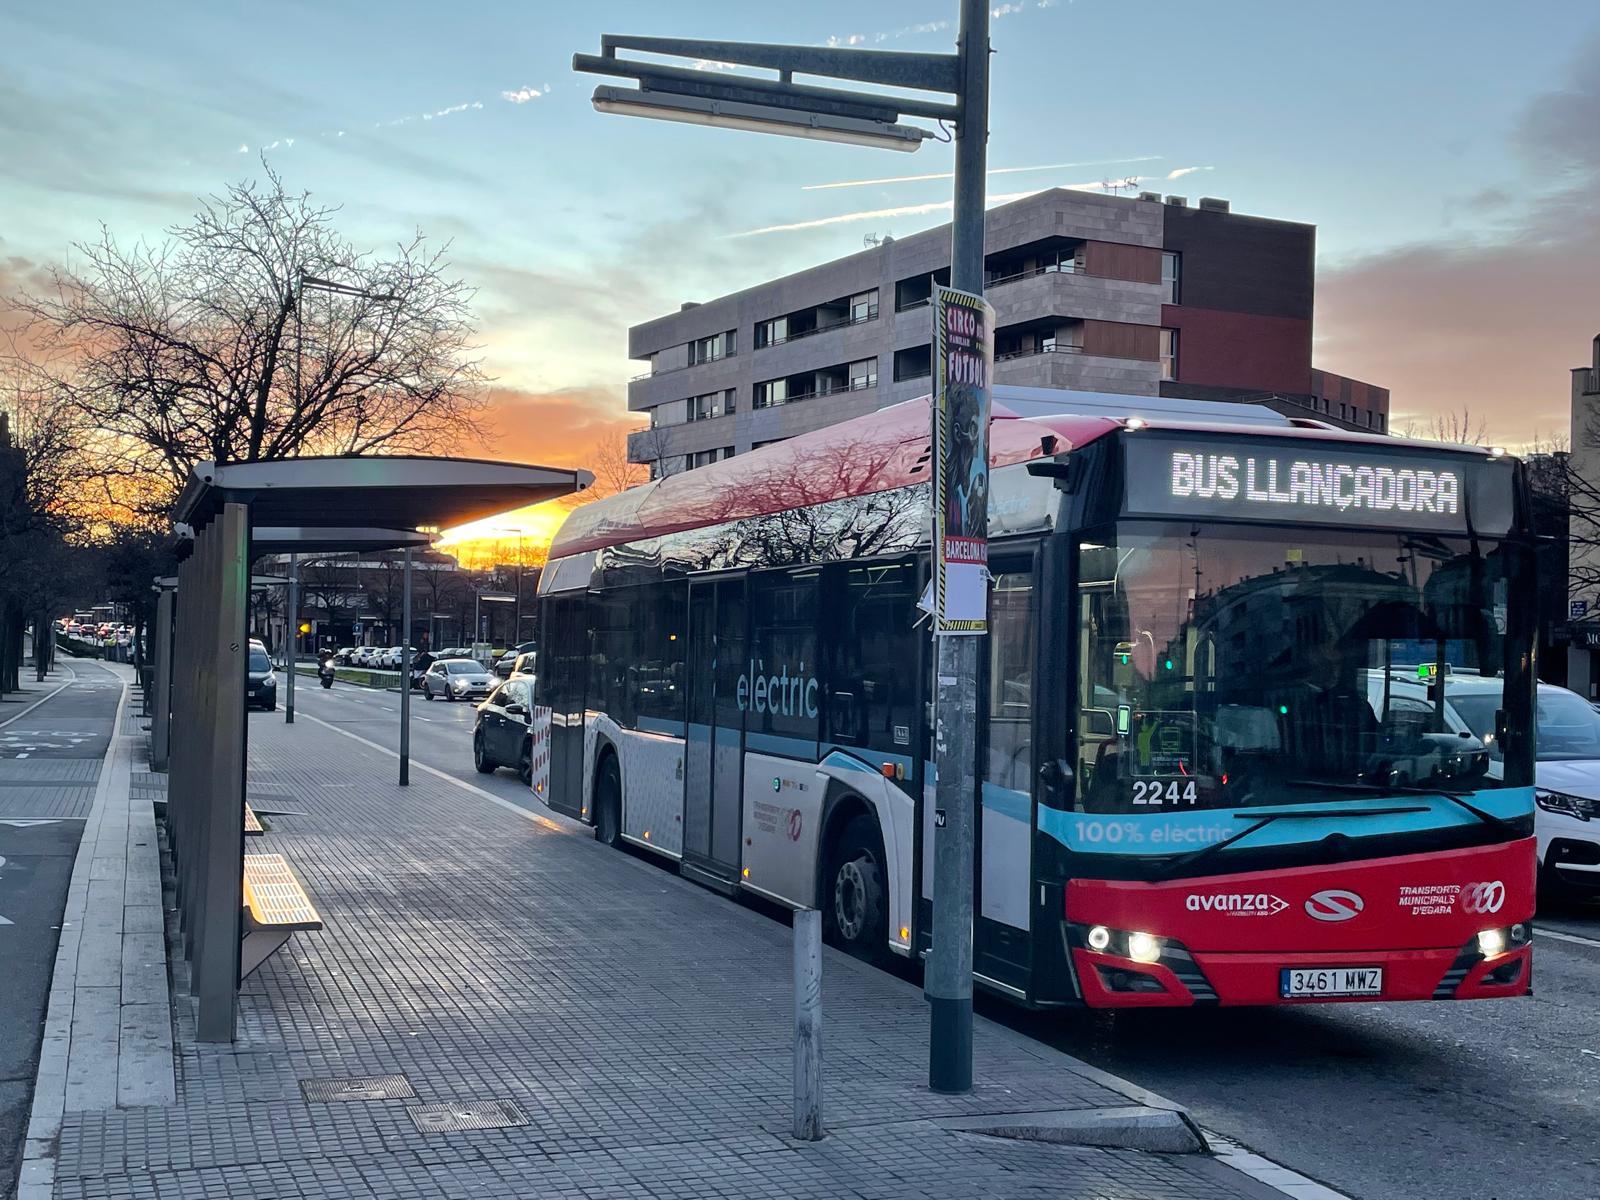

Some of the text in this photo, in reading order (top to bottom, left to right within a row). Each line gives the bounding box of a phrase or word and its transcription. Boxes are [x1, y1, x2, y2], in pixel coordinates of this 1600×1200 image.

[947, 307, 975, 337] CIRCO
[1172, 452, 1459, 514] BUS LLANÇADORA
[945, 539, 980, 561] BARCELONA
[736, 658, 819, 719] elèctric
[1132, 780, 1198, 805] 2244
[1075, 821, 1145, 844] 100%
[1398, 895, 1456, 906] MUNICIPALS
[1399, 885, 1460, 895] TRANSPORTS
[1186, 893, 1269, 911] avanza
[1412, 906, 1452, 916] D'EGARA
[1294, 970, 1379, 991] 3461 MWZ
